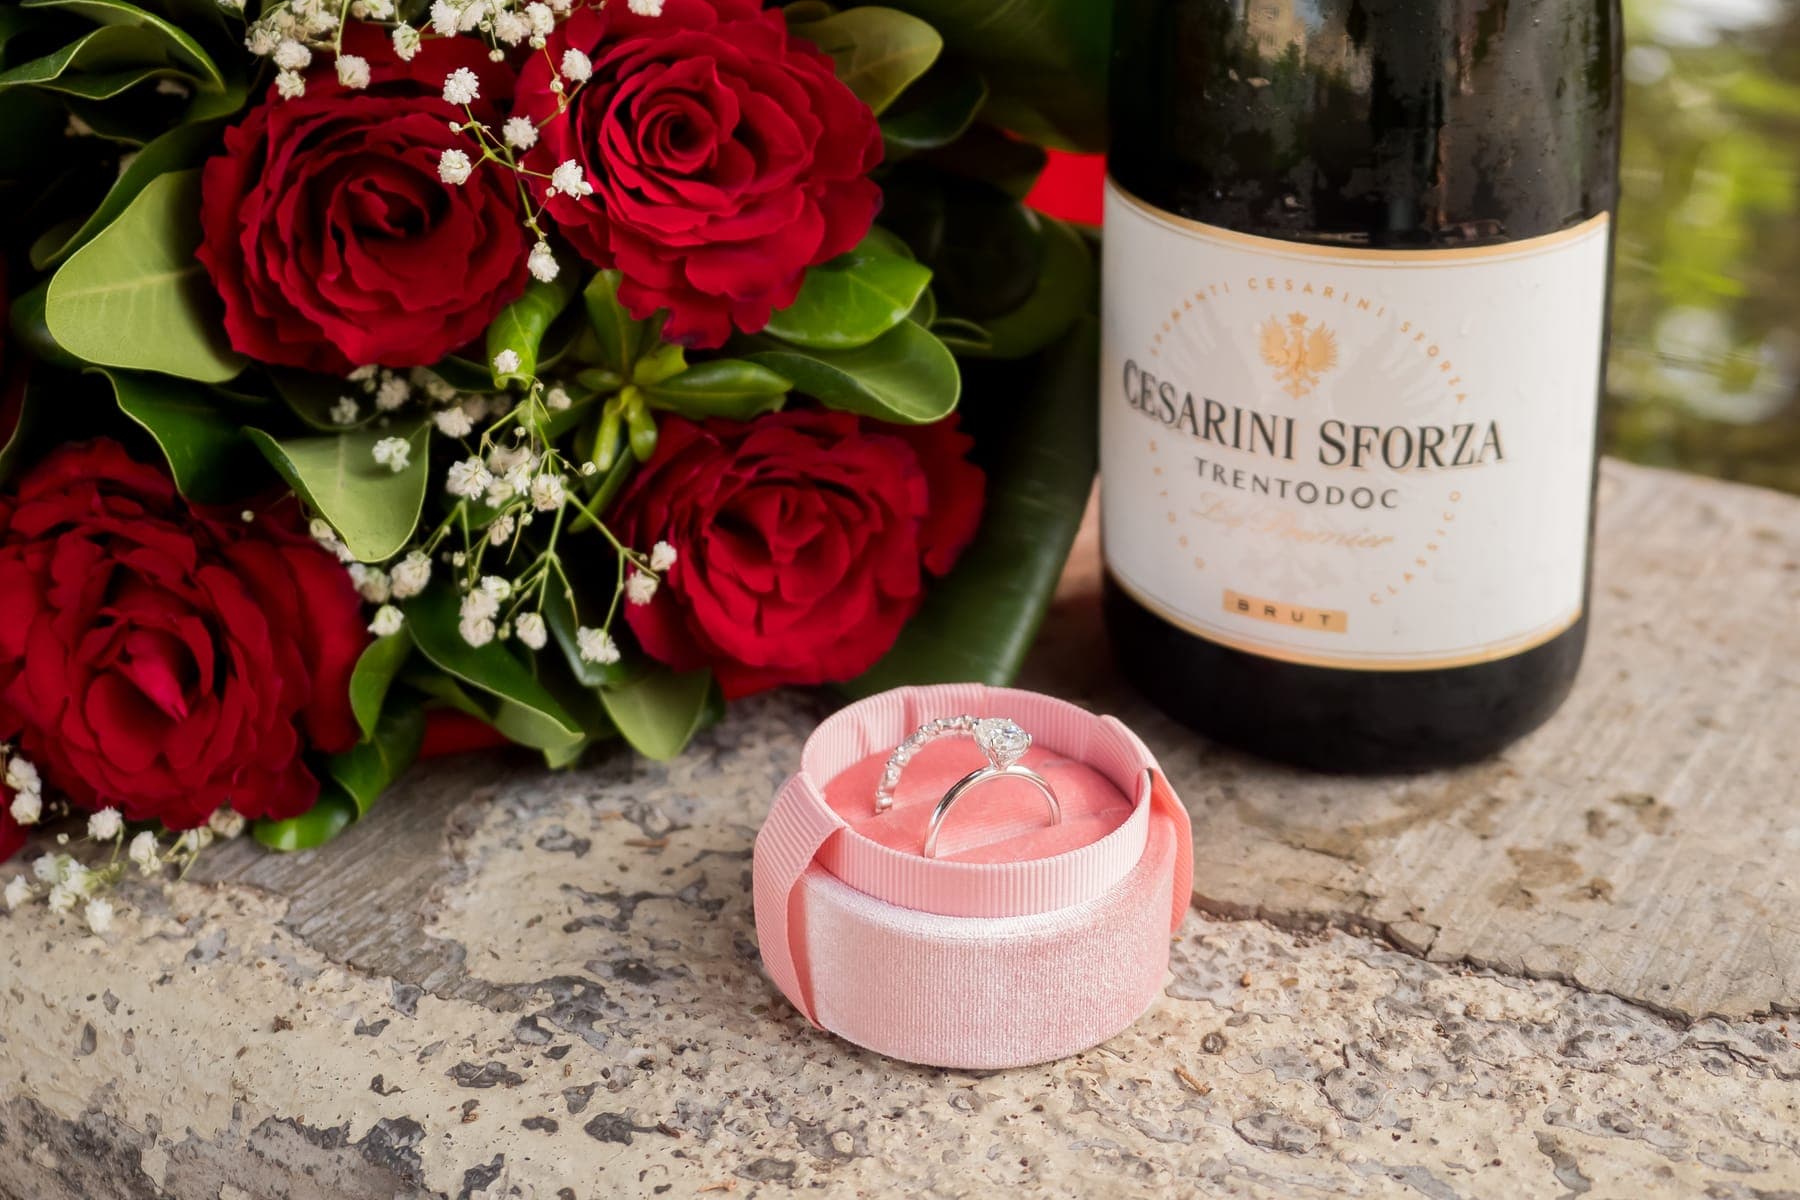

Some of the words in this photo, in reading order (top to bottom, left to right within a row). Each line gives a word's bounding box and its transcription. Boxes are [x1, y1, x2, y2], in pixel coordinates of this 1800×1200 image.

[1247, 276, 1386, 319] CESARINI
[1123, 358, 1297, 461] CESARINI
[1317, 418, 1505, 471] SFORZA
[1193, 456, 1399, 510] TRENTODOC
[1237, 599, 1331, 626] BRUT
